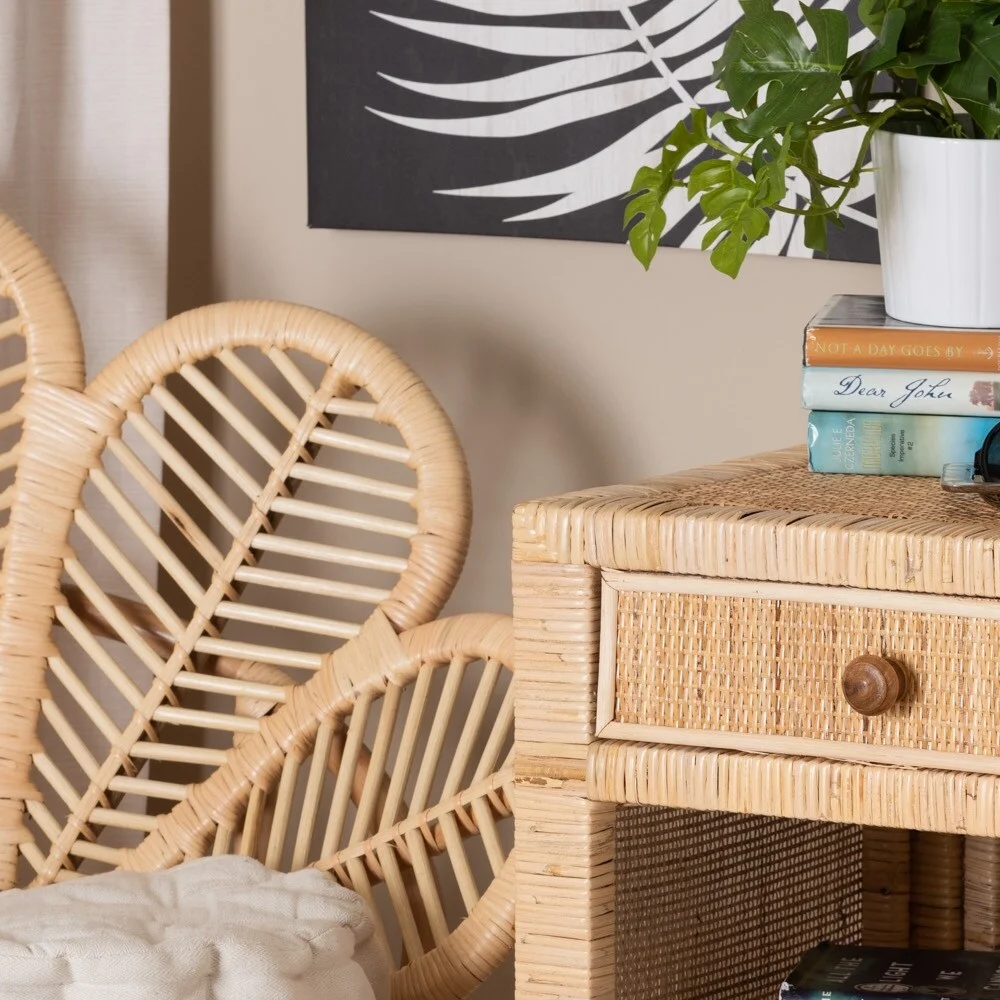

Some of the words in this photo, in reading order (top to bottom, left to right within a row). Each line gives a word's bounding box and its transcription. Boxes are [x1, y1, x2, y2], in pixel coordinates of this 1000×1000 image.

[814, 342, 847, 354] NOT
[854, 344, 862, 355] A
[868, 344, 896, 356] DAY
[901, 345, 940, 357] GOES
[945, 346, 963, 358] BY
[833, 374, 886, 396] Dear
[889, 378, 953, 409] John
[832, 435, 842, 462] JULIE
[844, 417, 856, 470] CZERNEDA
[879, 961, 913, 982] LIGHT
